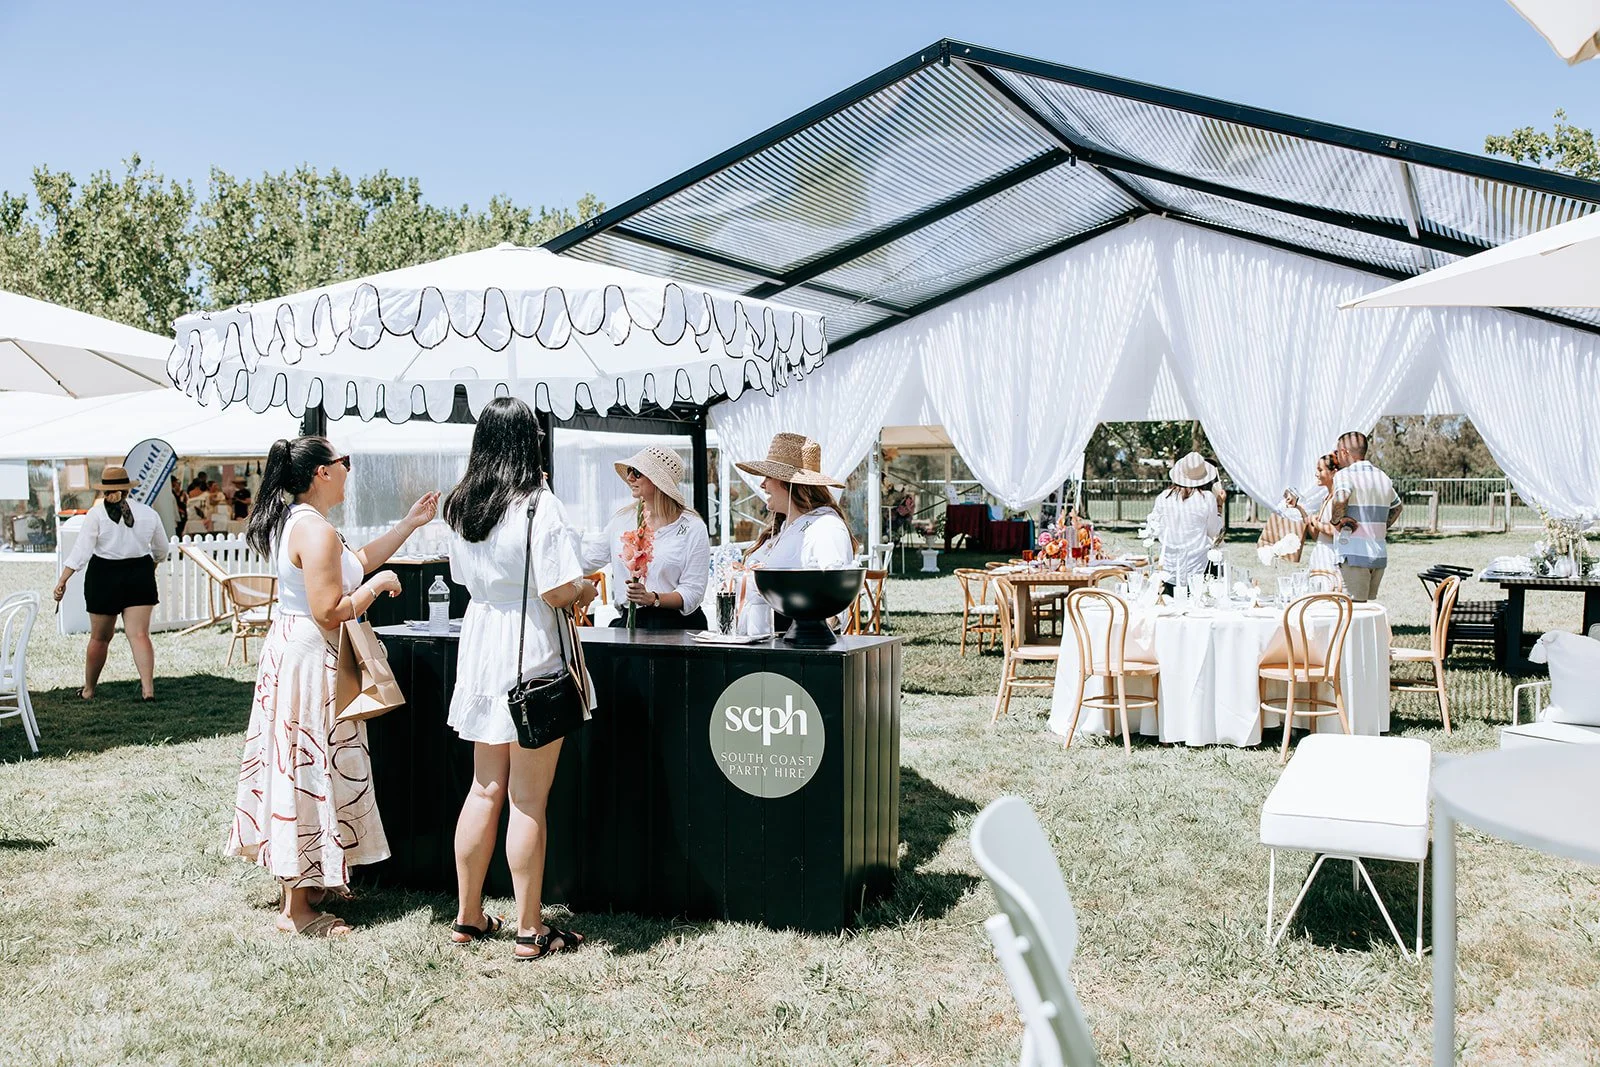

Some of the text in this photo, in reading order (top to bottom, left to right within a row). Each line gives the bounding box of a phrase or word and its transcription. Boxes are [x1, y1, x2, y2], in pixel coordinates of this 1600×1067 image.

[137, 443, 161, 487] vent
[725, 695, 807, 746] scph
[721, 752, 814, 766] SOUTH COAST
[729, 765, 806, 779] PARTY HIRE
